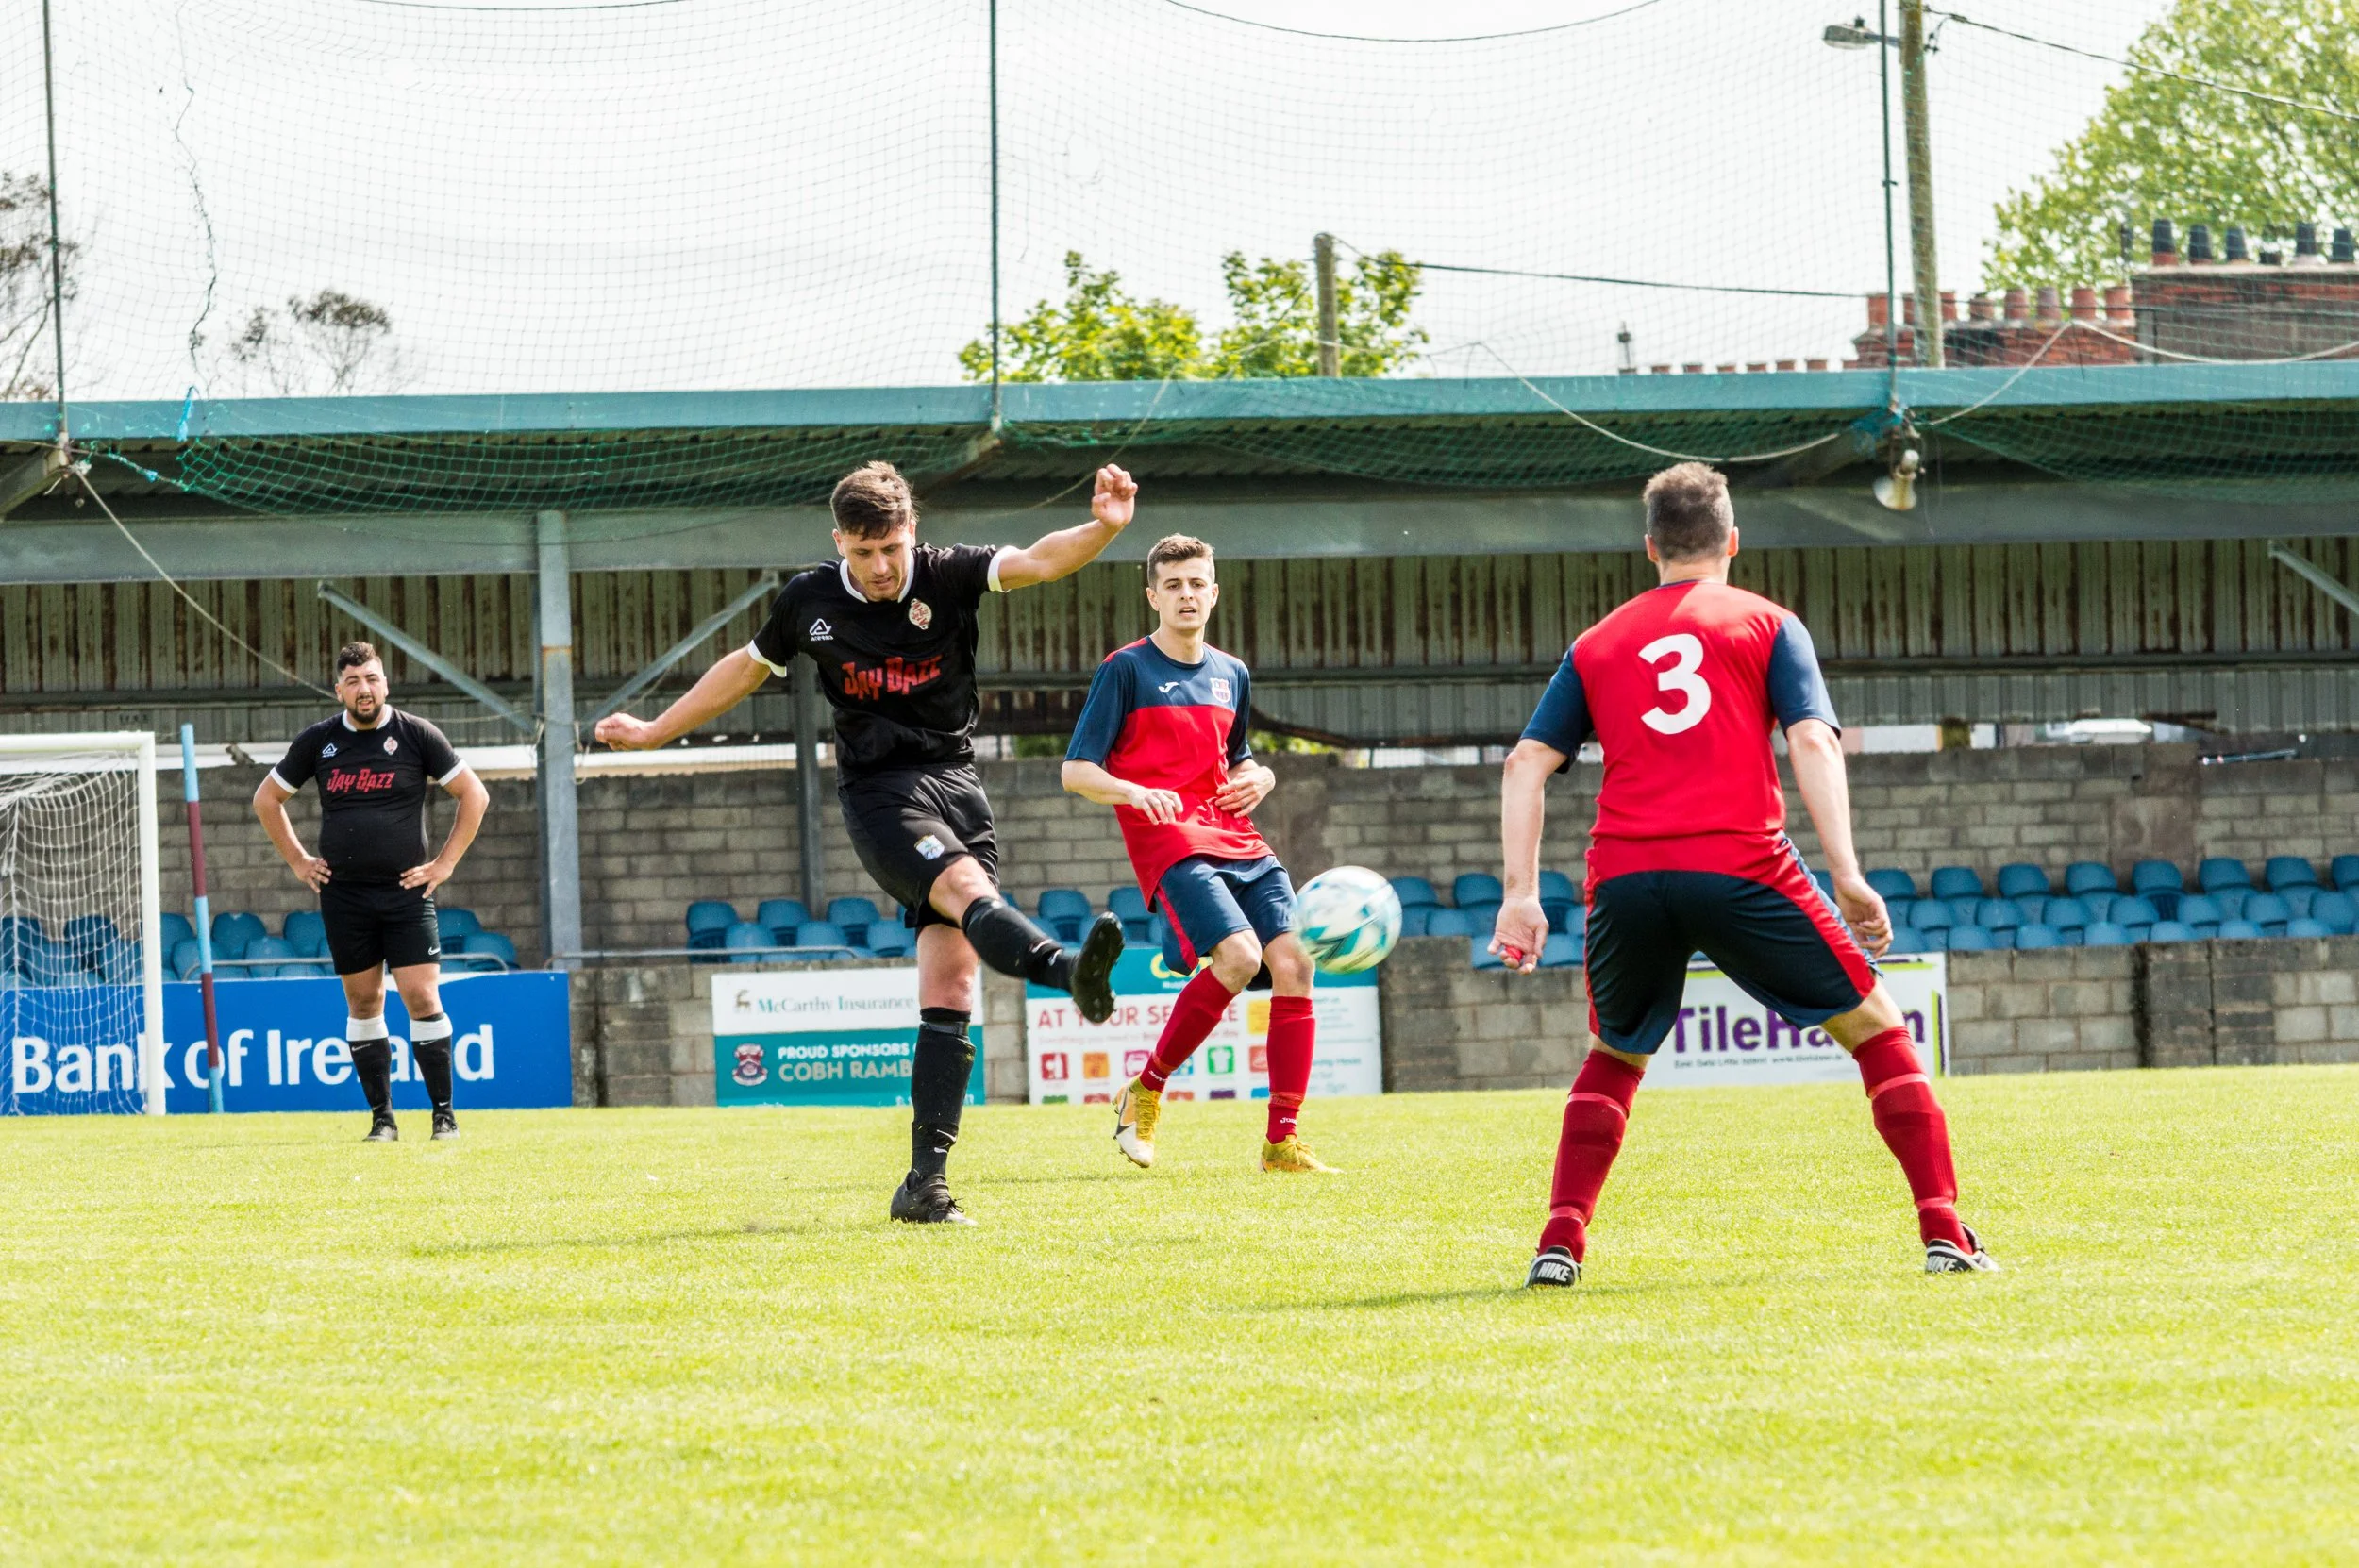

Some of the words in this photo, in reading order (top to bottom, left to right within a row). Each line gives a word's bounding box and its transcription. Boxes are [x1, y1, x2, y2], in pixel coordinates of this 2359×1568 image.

[1638, 633, 1712, 735] 3
[758, 995, 831, 1014] McCarthy
[838, 994, 914, 1011] Insurance
[1038, 1009, 1065, 1027] AT
[1075, 1006, 1139, 1027] YUR
[778, 1045, 828, 1059] PROUD
[831, 1042, 910, 1058] SPONSORS
[12, 1032, 176, 1094] Bank
[184, 1029, 254, 1089] of
[778, 1060, 844, 1082] COBH
[849, 1059, 912, 1079] RAMB
[1537, 1262, 1571, 1282] NIKE
